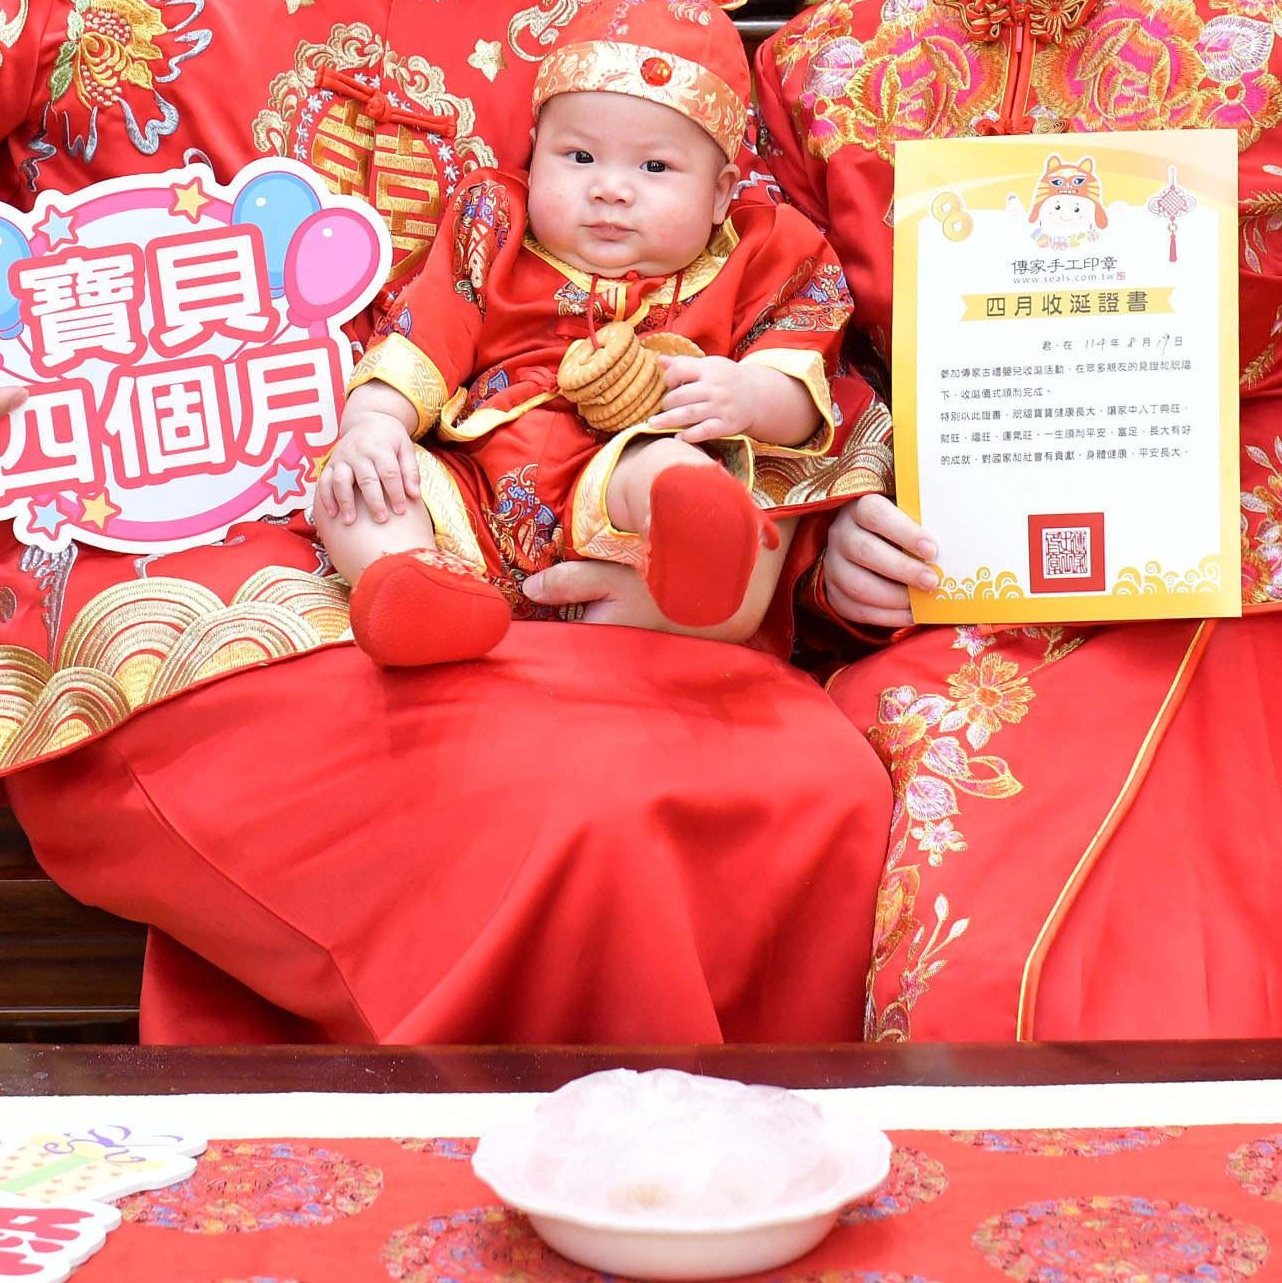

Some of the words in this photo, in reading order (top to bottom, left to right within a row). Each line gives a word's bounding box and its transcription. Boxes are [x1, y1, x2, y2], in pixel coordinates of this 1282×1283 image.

[1011, 256, 1118, 276] 傳家手工印章
[1012, 272, 1116, 285] www.seals.com.tw
[18, 233, 271, 369] 寶貝
[986, 290, 1149, 317] 四月收涎證書
